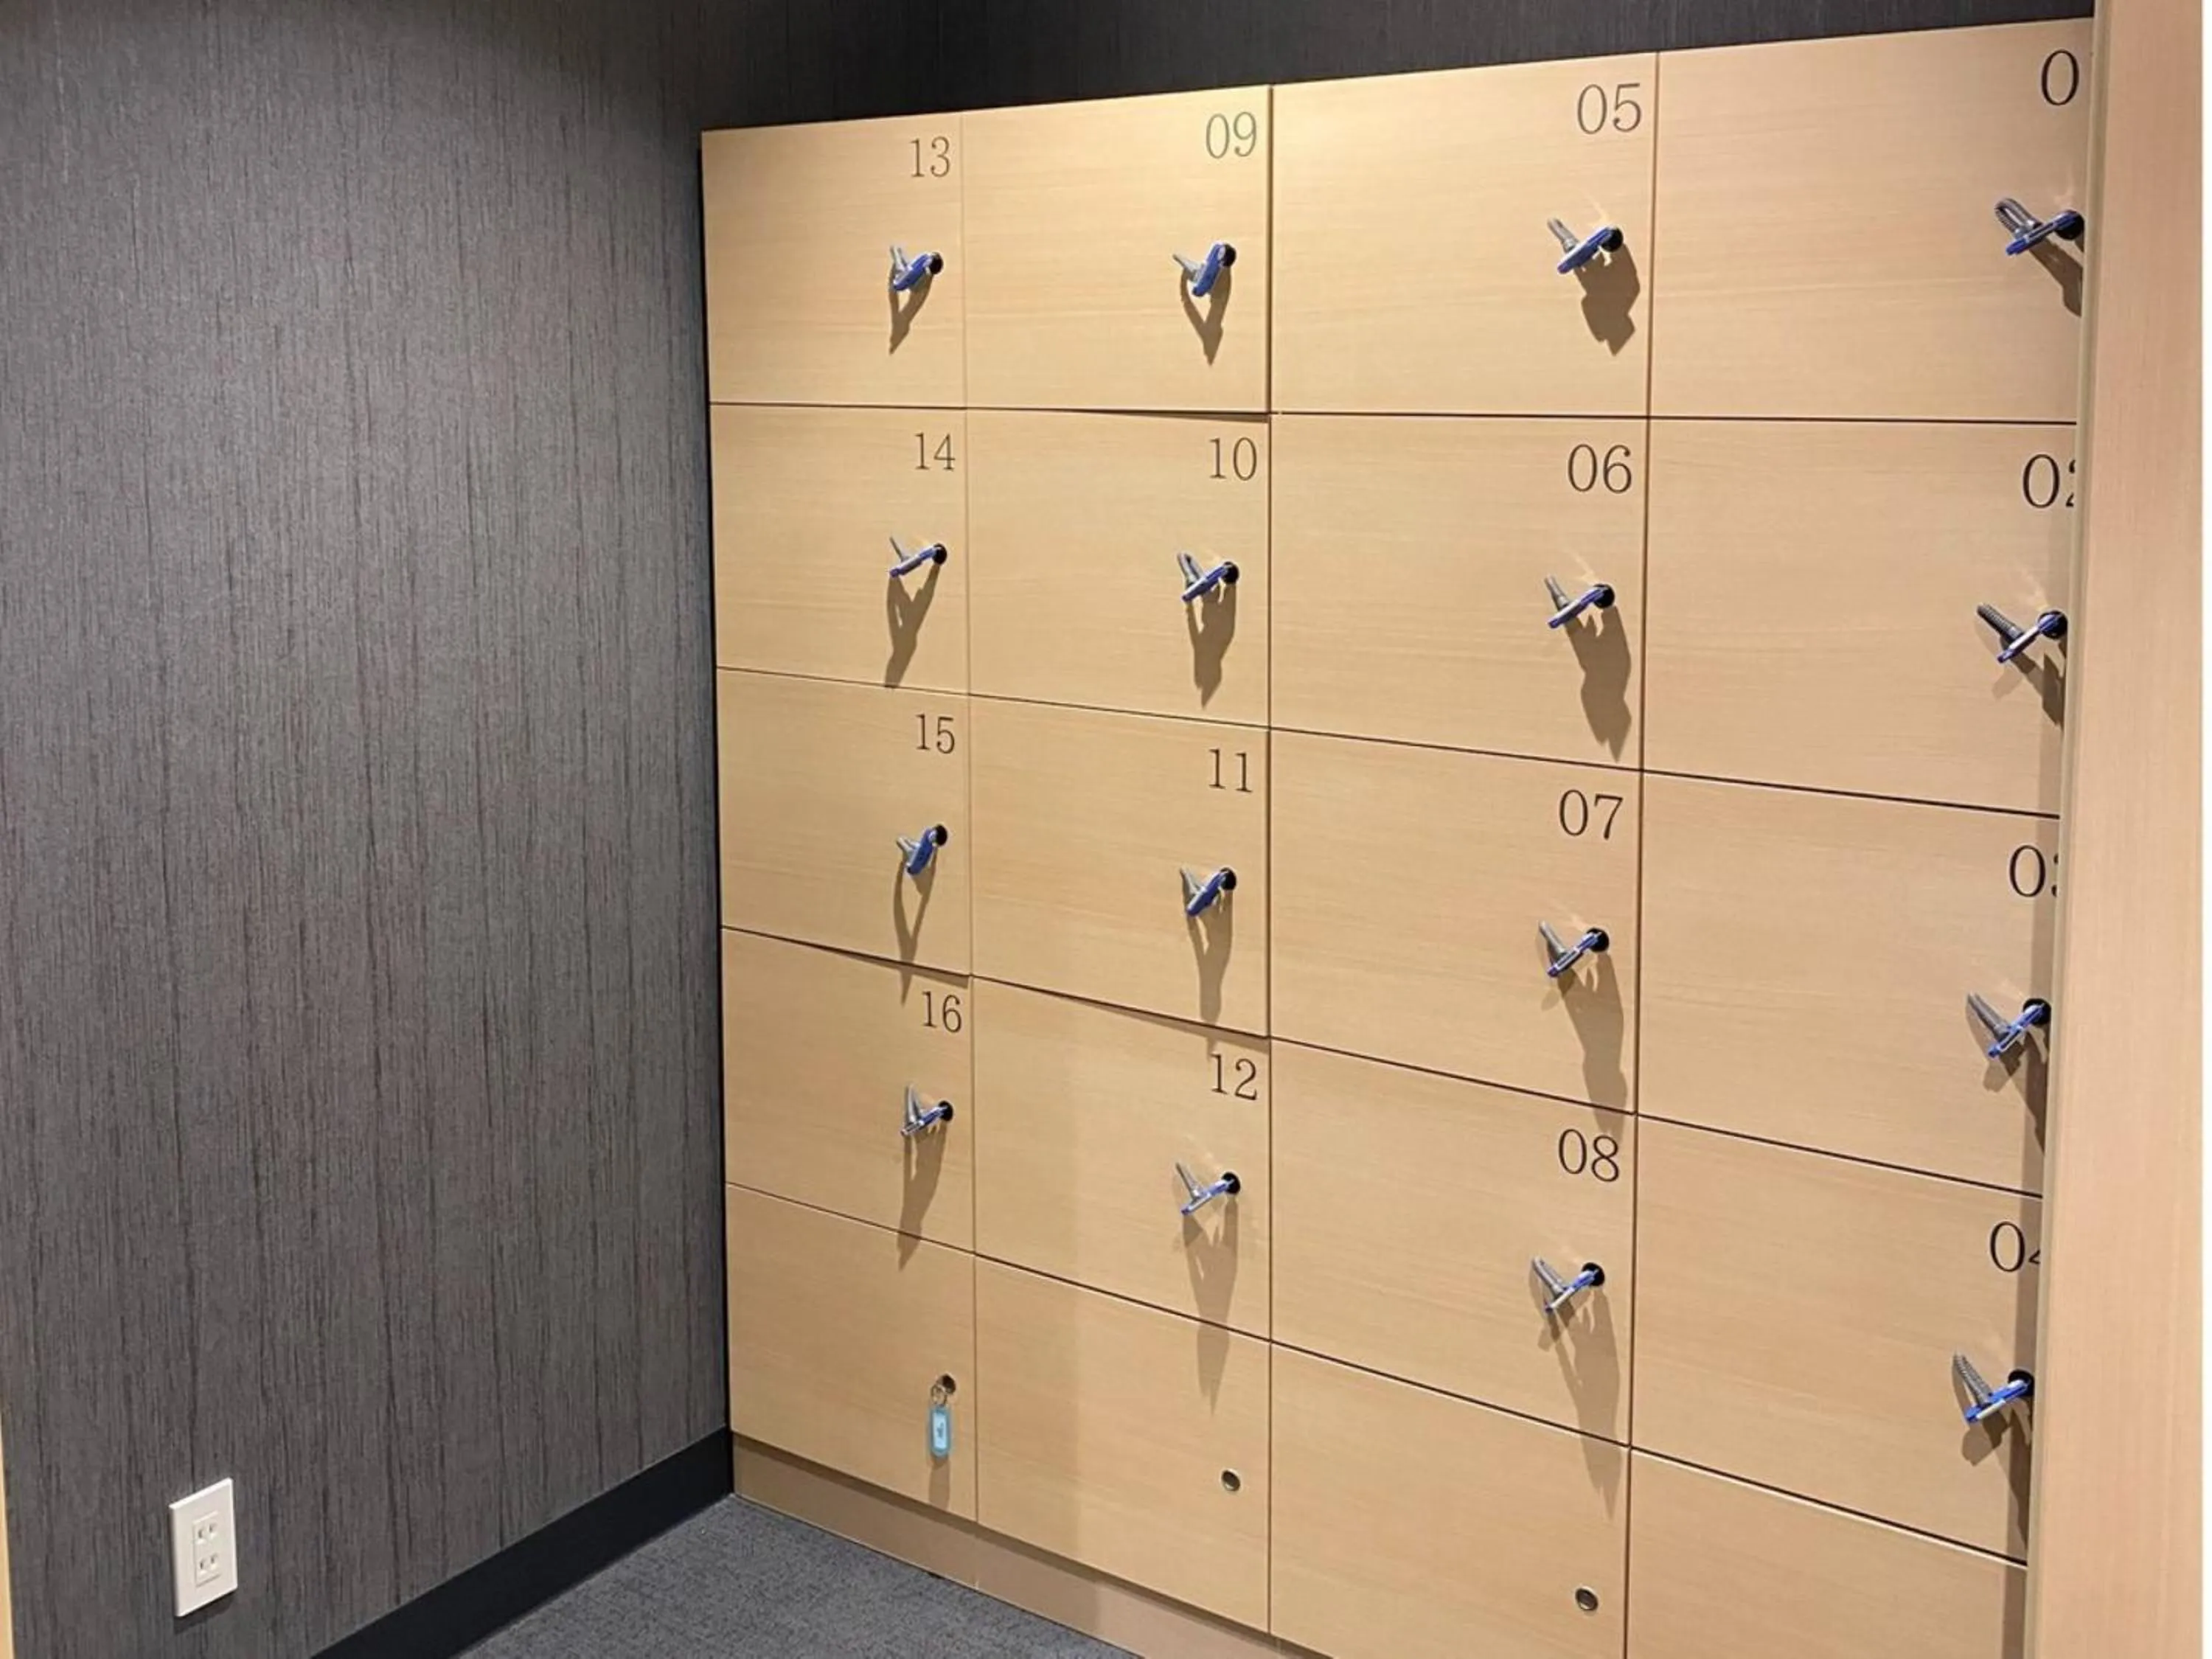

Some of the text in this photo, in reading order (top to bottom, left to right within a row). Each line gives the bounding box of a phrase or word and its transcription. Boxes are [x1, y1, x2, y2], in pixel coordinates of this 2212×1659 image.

[2041, 49, 2092, 106] 0
[1577, 83, 1642, 135] 05
[910, 136, 951, 178] 13
[1206, 111, 1258, 159] 09
[914, 432, 957, 471] 14
[1209, 437, 1258, 481] 10
[1568, 443, 1632, 494] 06
[2023, 453, 2076, 509] 0
[916, 713, 956, 754] 15
[1208, 748, 1253, 793] 11
[1559, 789, 1624, 841] 07
[2009, 844, 2059, 897] 0
[922, 990, 962, 1033] 16
[1209, 1053, 1259, 1101] 12
[1558, 1128, 1620, 1183] 08
